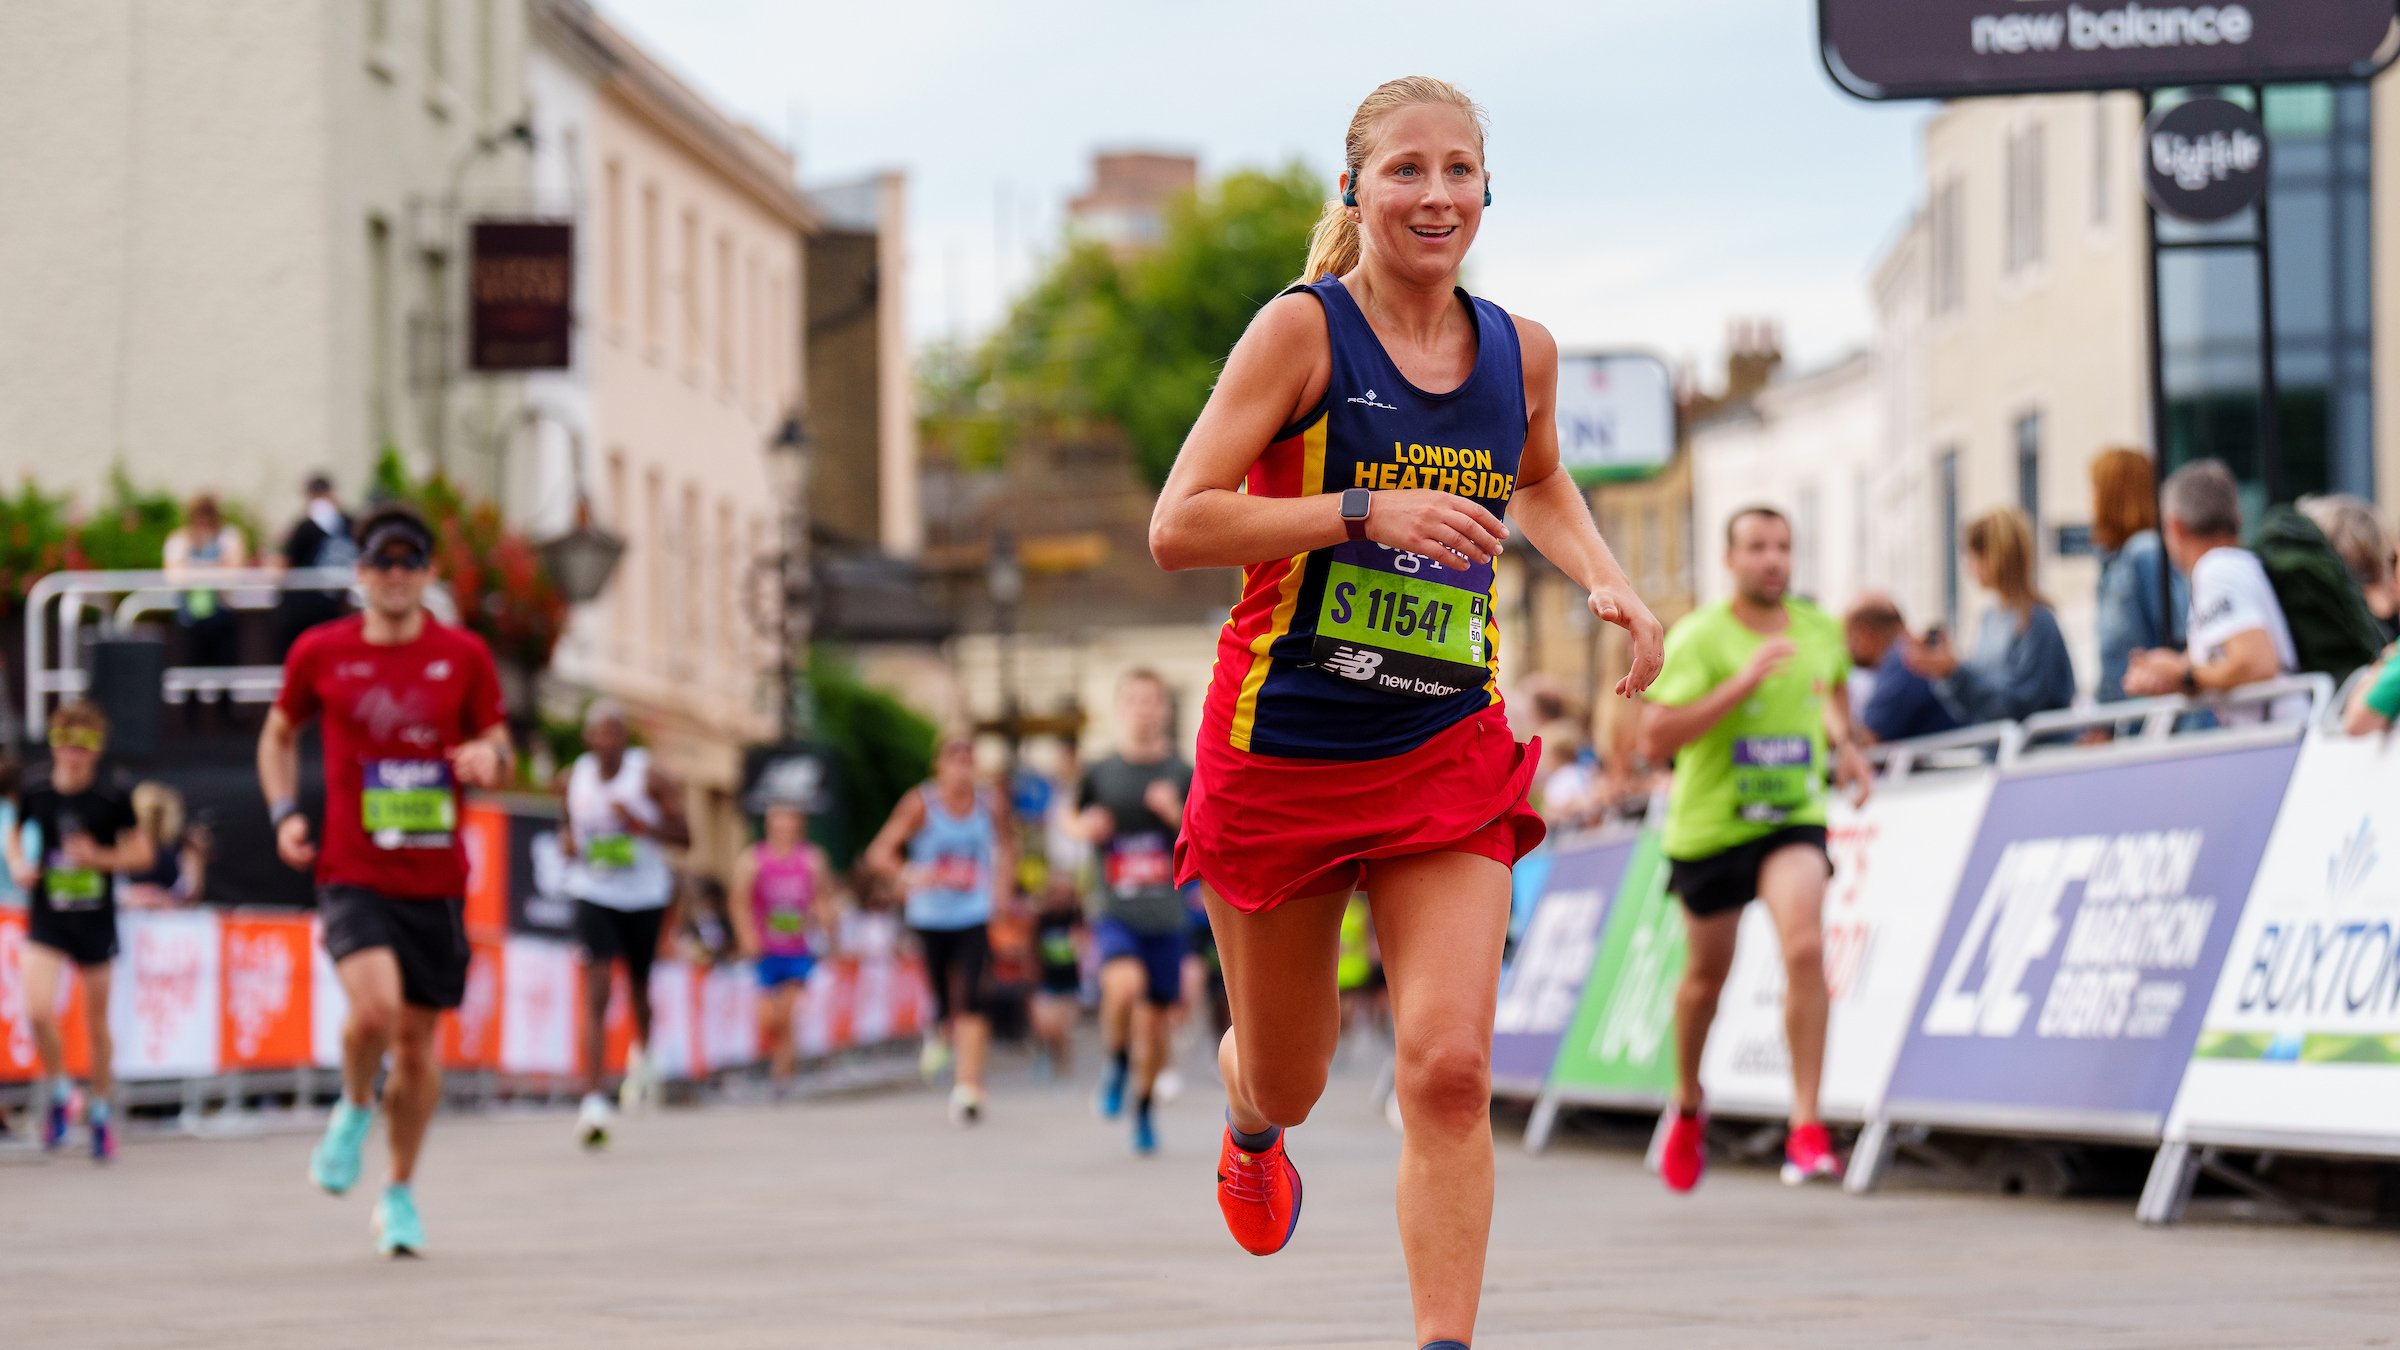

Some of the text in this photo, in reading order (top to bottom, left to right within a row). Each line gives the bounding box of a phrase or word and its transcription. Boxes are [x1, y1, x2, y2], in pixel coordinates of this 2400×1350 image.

[1971, 1, 2253, 54] new balance
[1394, 441, 1493, 471] LONDON
[1354, 461, 1514, 501] HEATHSIDE
[1330, 581, 1453, 645] S 11547
[1471, 630, 1481, 642] 50
[1379, 673, 1413, 690] new
